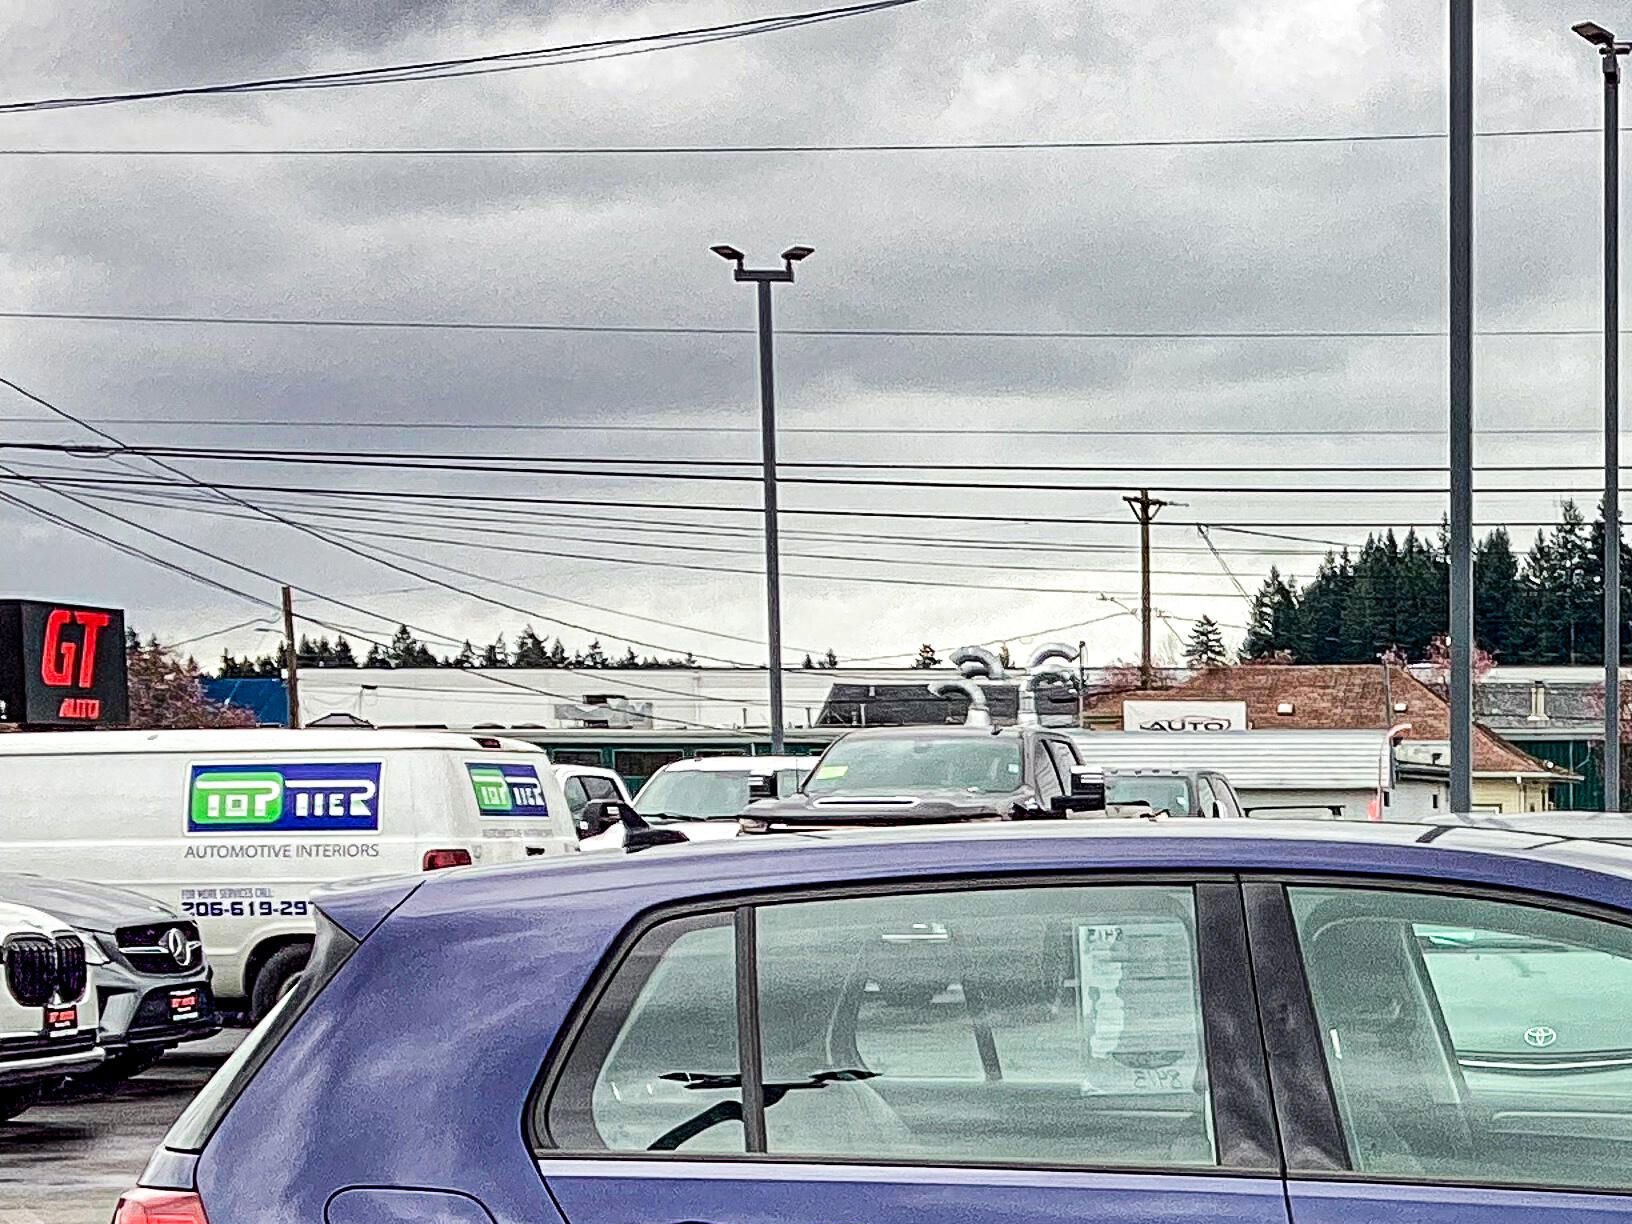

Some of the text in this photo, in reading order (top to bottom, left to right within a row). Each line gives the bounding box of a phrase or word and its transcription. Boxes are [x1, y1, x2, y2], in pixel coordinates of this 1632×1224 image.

[41, 609, 110, 688] GT
[58, 698, 101, 719] AUTO
[196, 779, 376, 817] TOP TIER
[184, 844, 379, 859] AUTOMOTIVE INTERIORS
